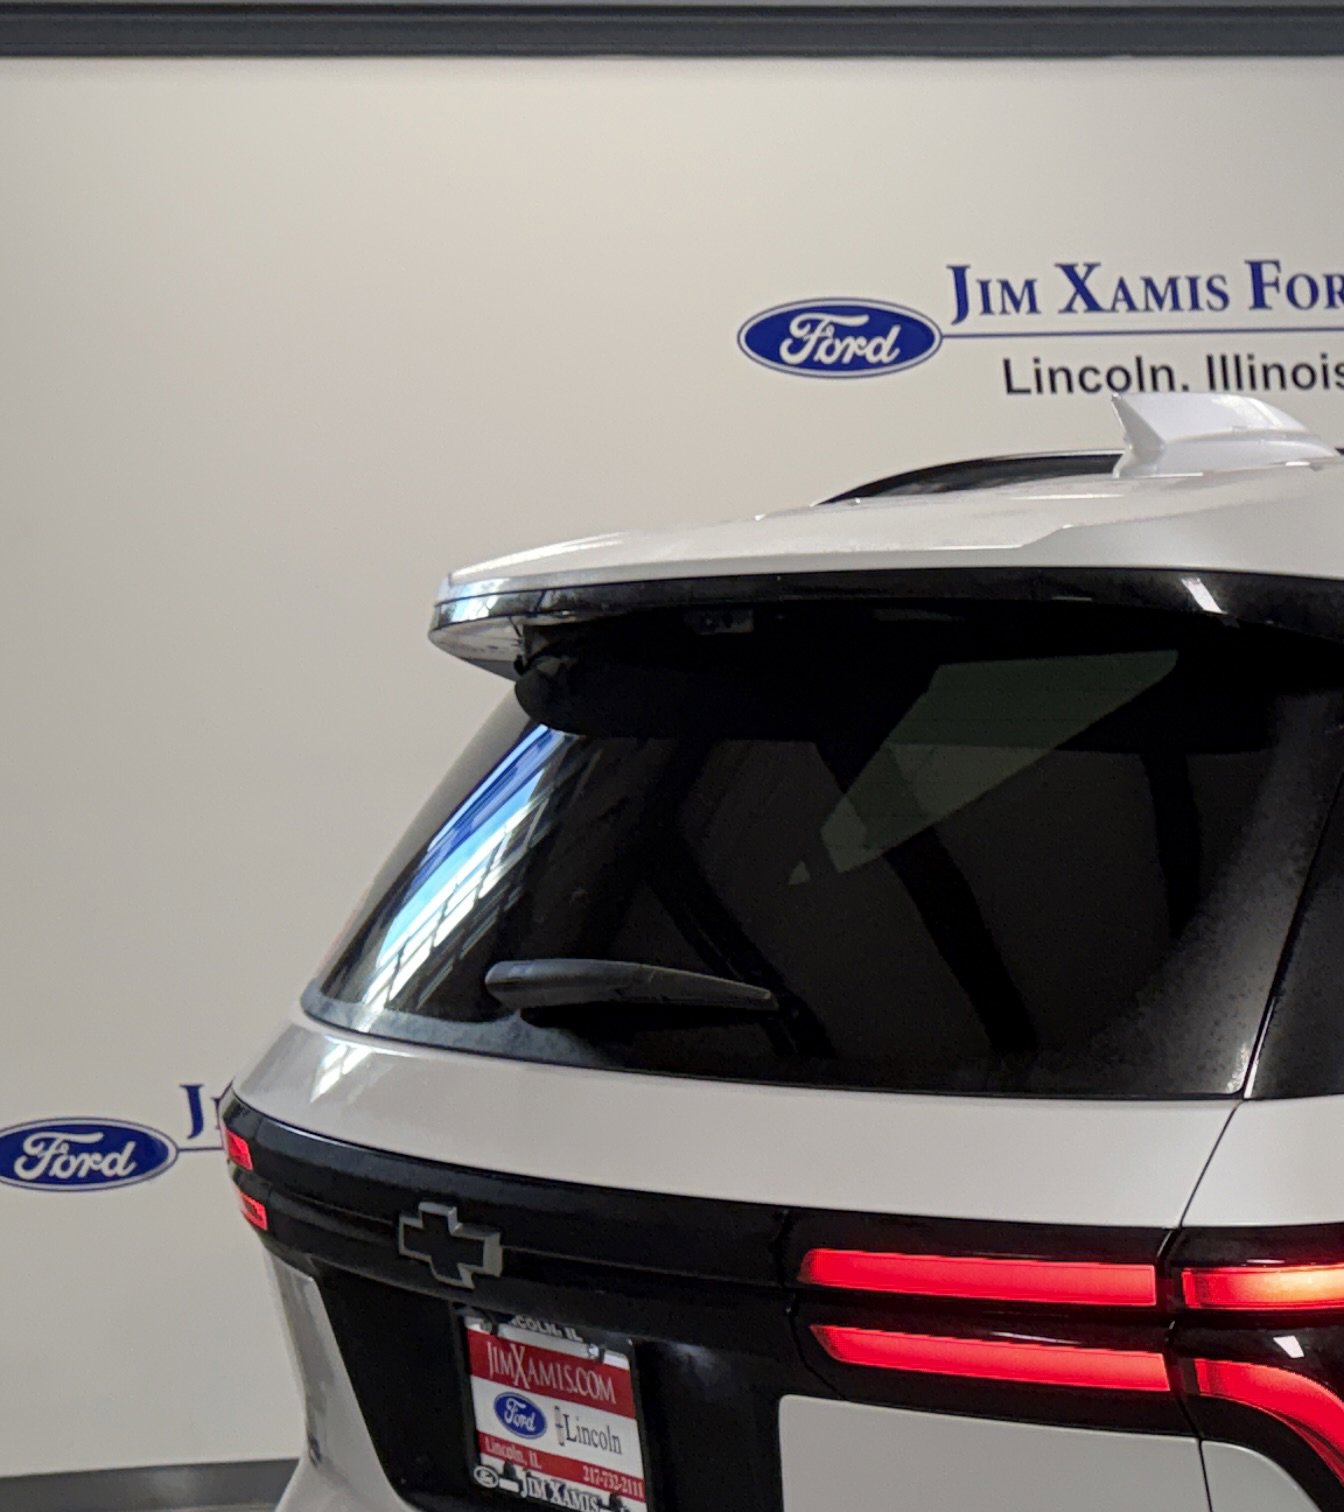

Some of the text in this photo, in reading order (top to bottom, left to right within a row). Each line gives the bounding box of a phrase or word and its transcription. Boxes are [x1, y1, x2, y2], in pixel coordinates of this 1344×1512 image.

[946, 264, 1042, 326] JIM
[1054, 262, 1231, 314] XAMIS
[779, 311, 901, 366] Ford
[13, 1131, 137, 1180] Ford
[486, 1341, 617, 1405] JIMXAMIS.COM
[503, 1397, 537, 1432] Ford
[562, 1413, 623, 1455] Lincoln
